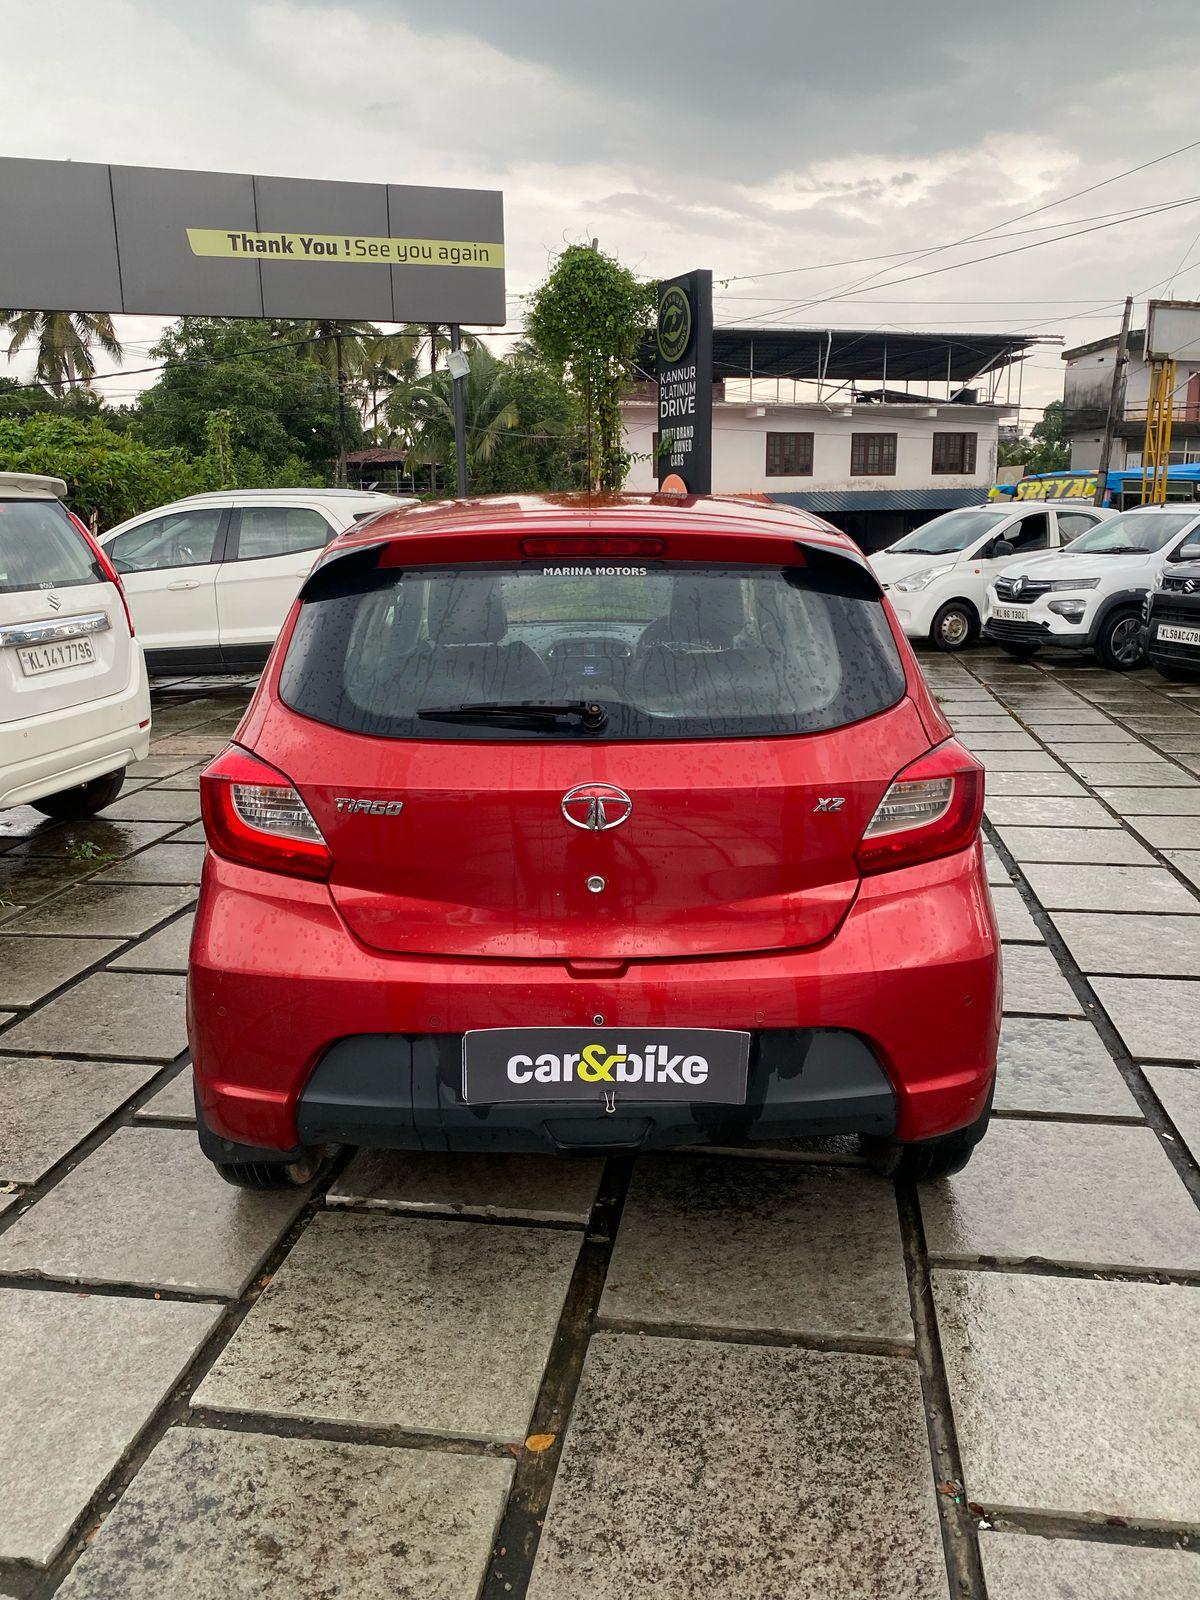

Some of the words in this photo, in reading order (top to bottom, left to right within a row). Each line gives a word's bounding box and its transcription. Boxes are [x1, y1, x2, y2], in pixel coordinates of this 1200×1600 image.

[227, 233, 294, 254] Thank
[300, 237, 338, 256] You
[355, 240, 391, 257] See
[397, 245, 432, 262] you
[438, 244, 490, 264] again
[660, 366, 696, 384] KANNUR
[660, 381, 696, 400] PLATINUM
[660, 396, 696, 418] DRIVE
[676, 425, 694, 439] BRAND
[670, 453, 685, 467] CARS
[543, 567, 592, 576] MARINA
[595, 567, 647, 576] MOTORS
[1161, 628, 1200, 643] KL58AC478
[334, 797, 404, 816] TIAGO
[813, 797, 846, 812] XZ
[507, 1044, 709, 1085] car&bike
